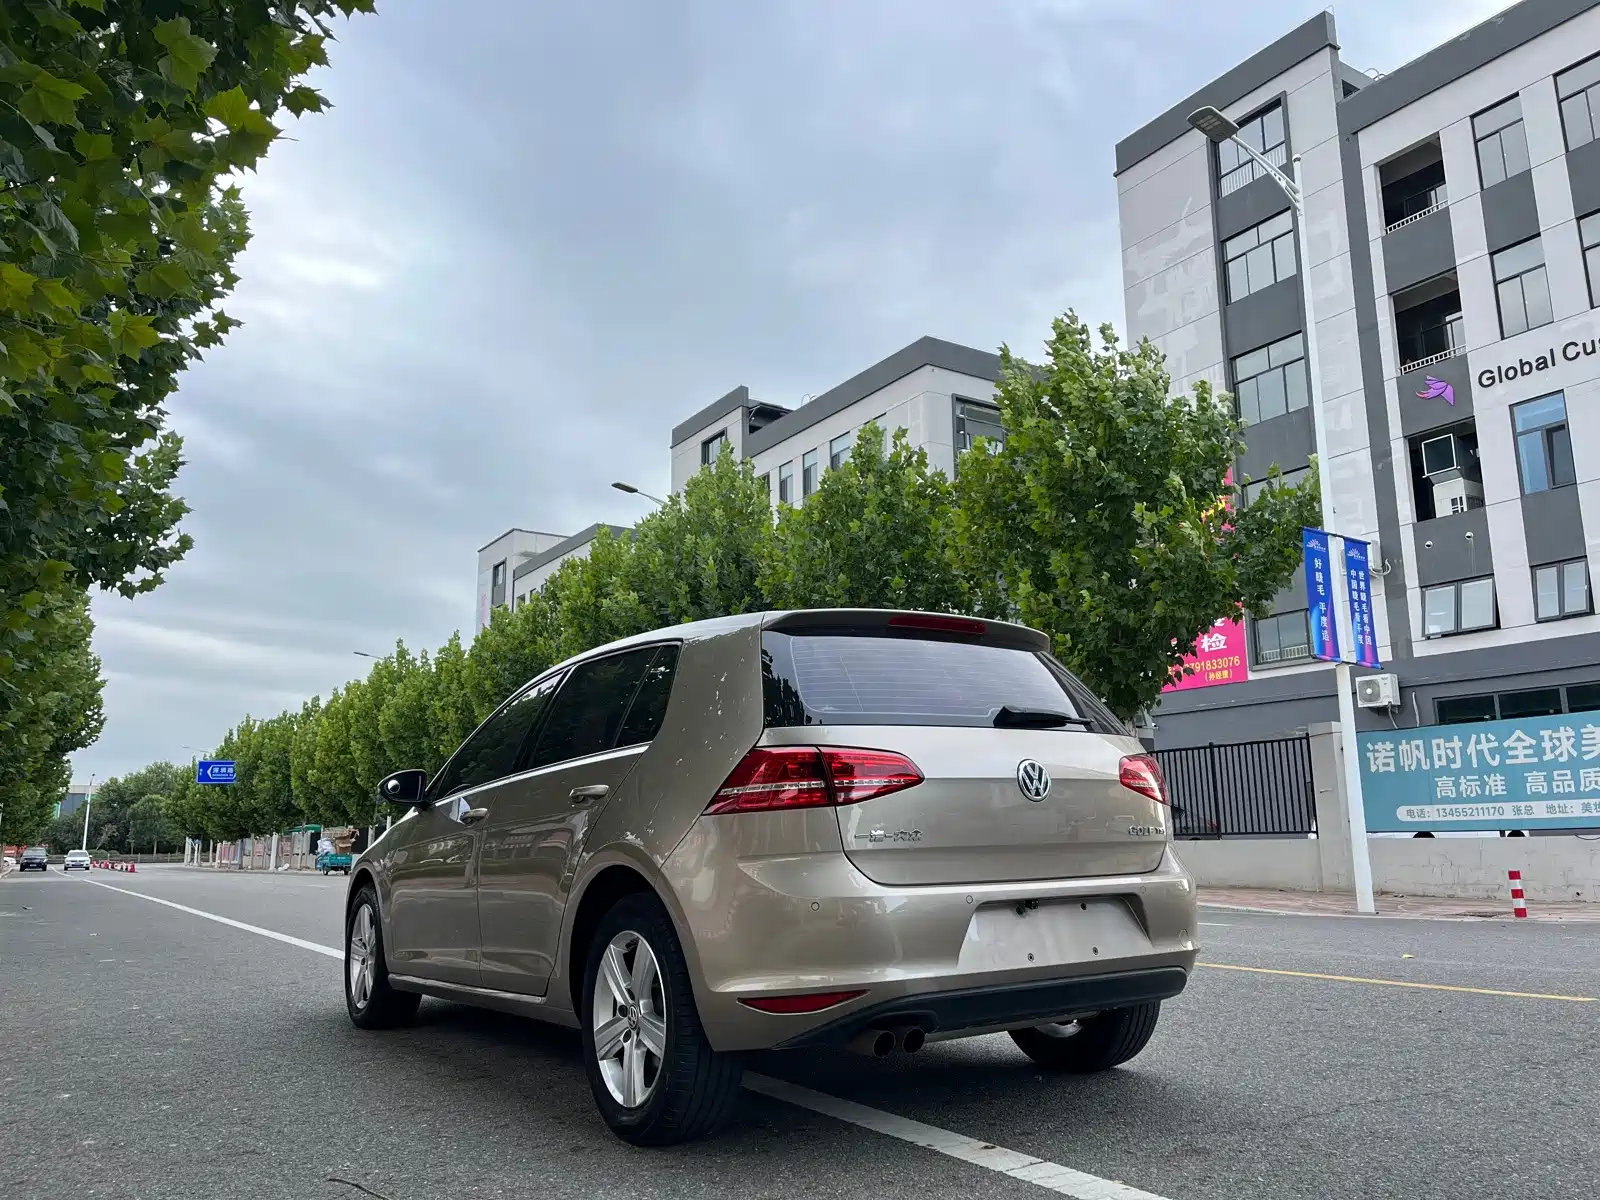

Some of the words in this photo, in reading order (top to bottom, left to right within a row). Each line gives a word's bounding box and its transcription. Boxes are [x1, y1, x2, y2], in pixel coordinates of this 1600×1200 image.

[1478, 348, 1556, 389] Global
[1562, 337, 1600, 362] Cu
[1434, 773, 1507, 799] 高标准
[1523, 766, 1600, 795] 高品质
[1512, 805, 1534, 816] 张总
